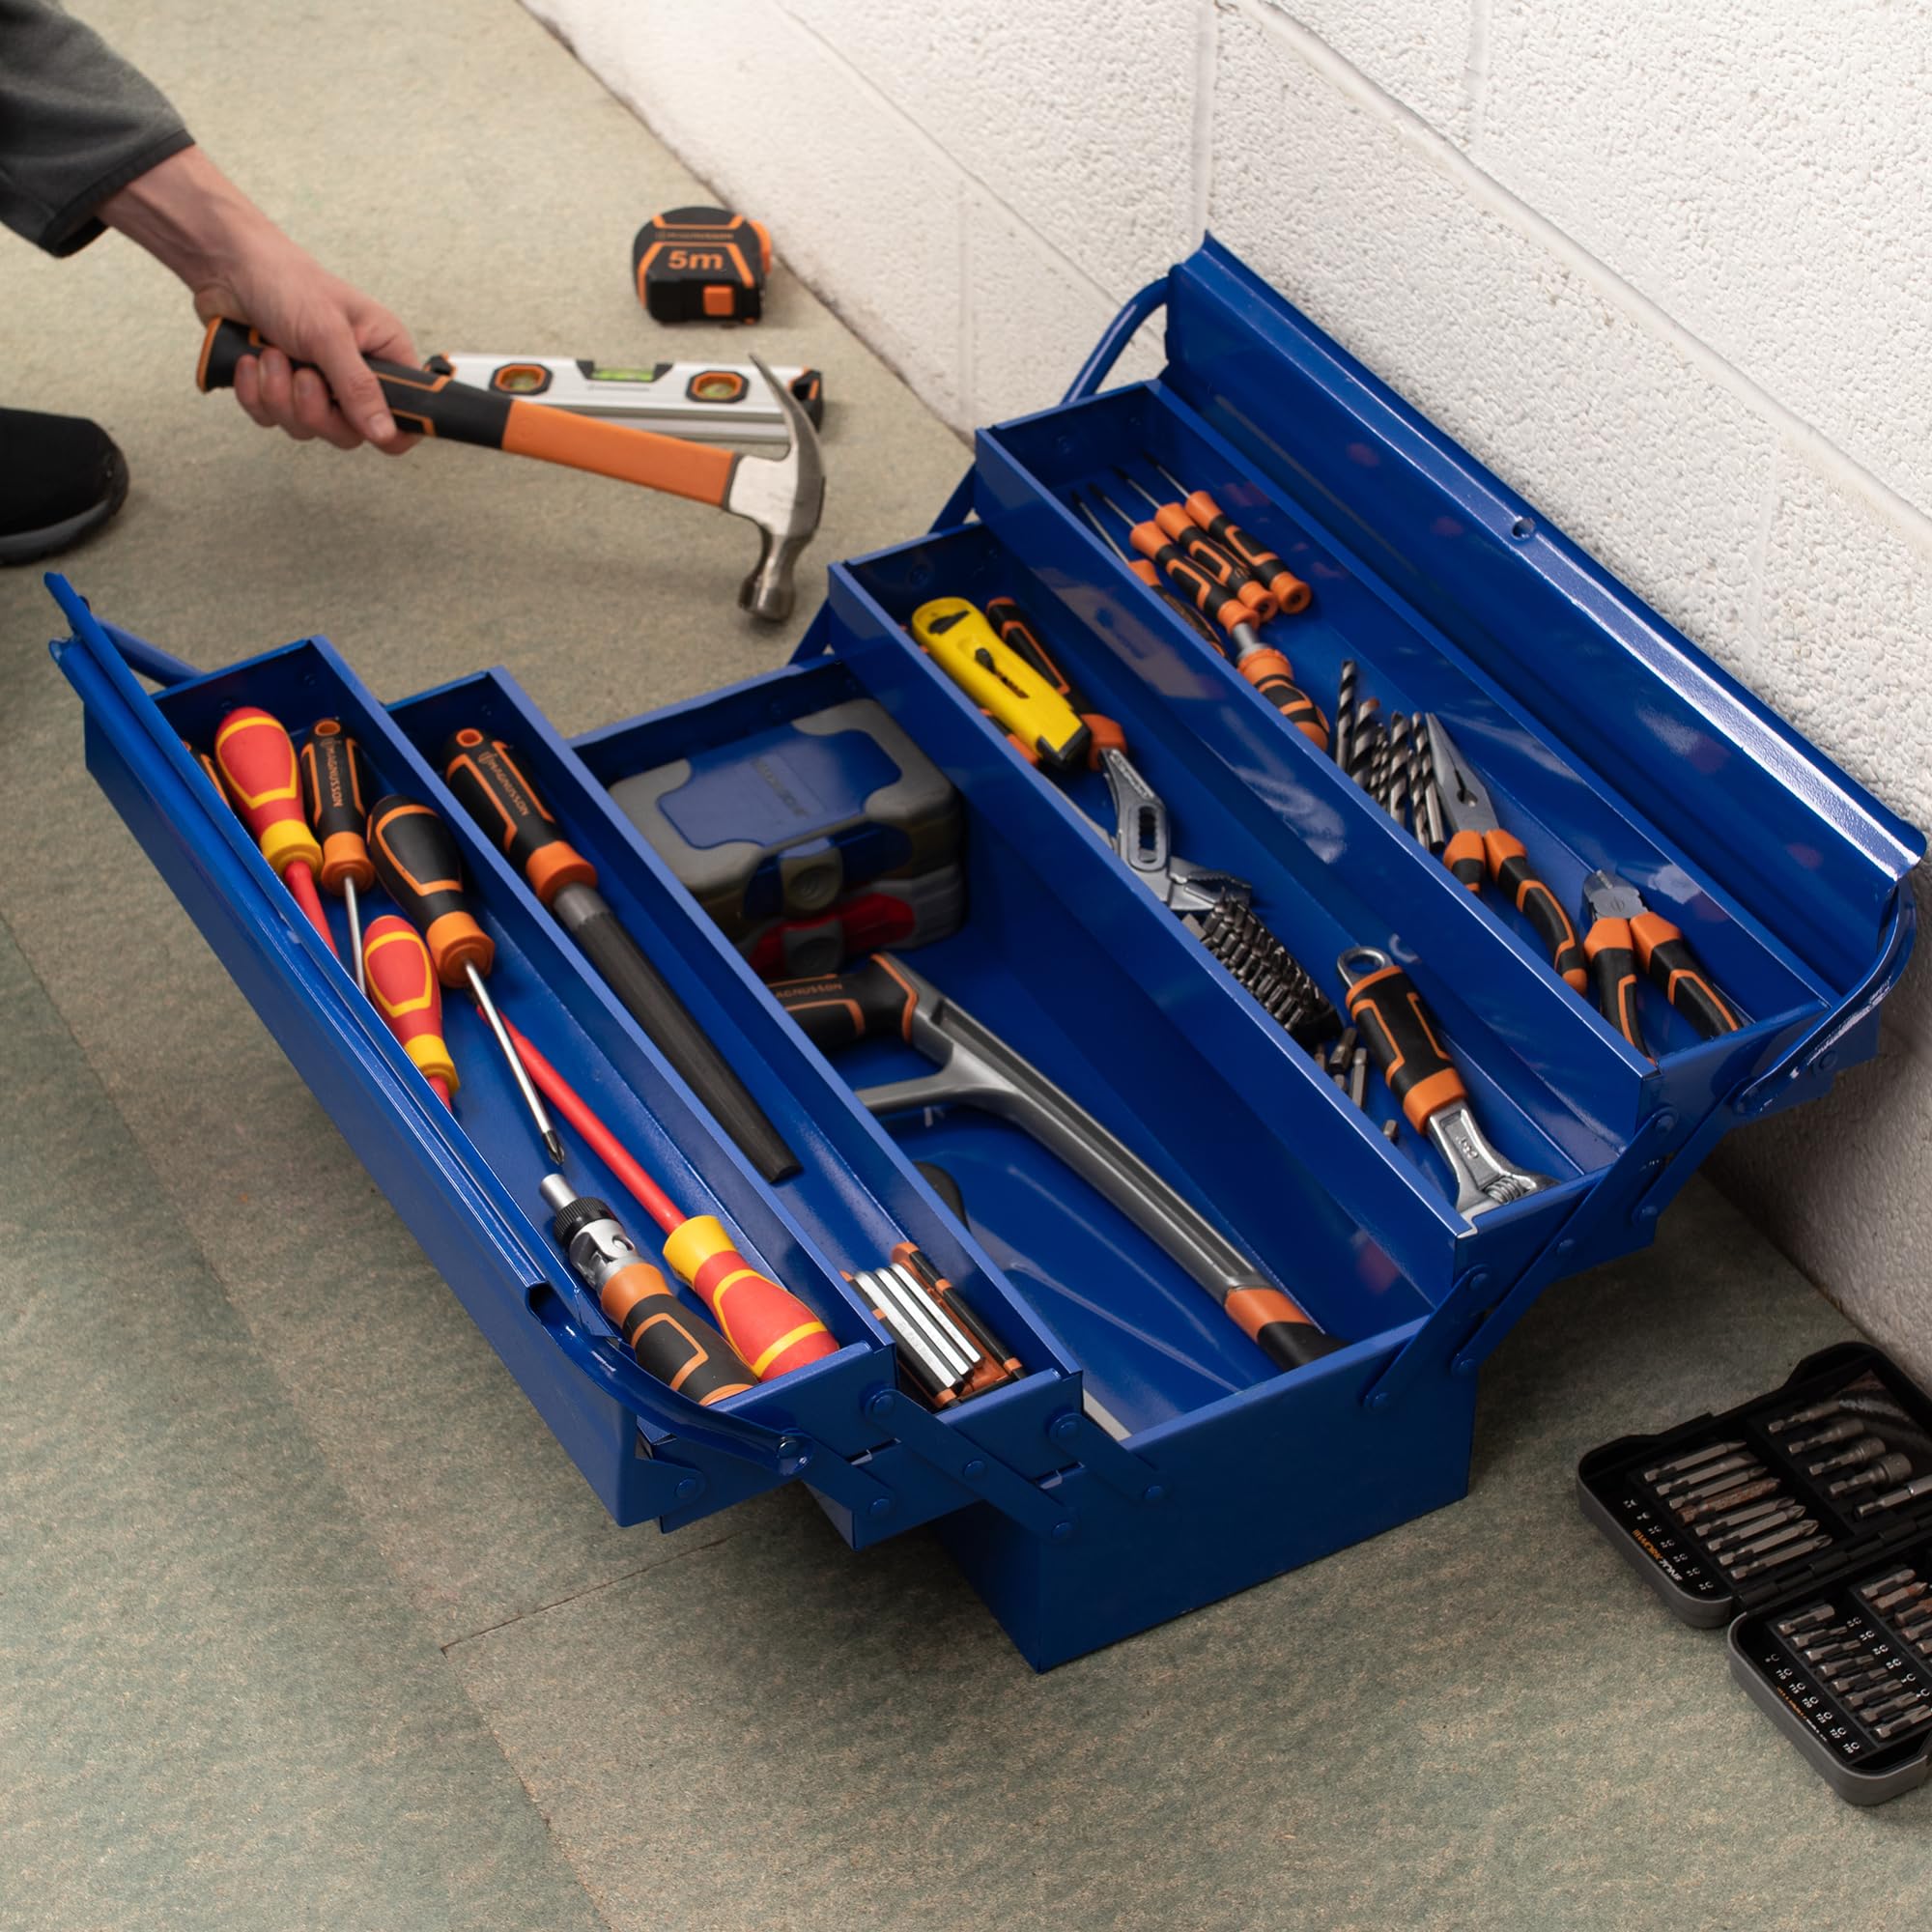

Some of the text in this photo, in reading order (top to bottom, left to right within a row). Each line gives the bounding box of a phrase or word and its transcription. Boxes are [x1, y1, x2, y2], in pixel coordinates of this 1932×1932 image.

[668, 250, 724, 270] 5m
[327, 746, 344, 808] MAGNUSSON
[488, 759, 530, 816] MAGNUSSON
[776, 982, 843, 999] AGNUSSON
